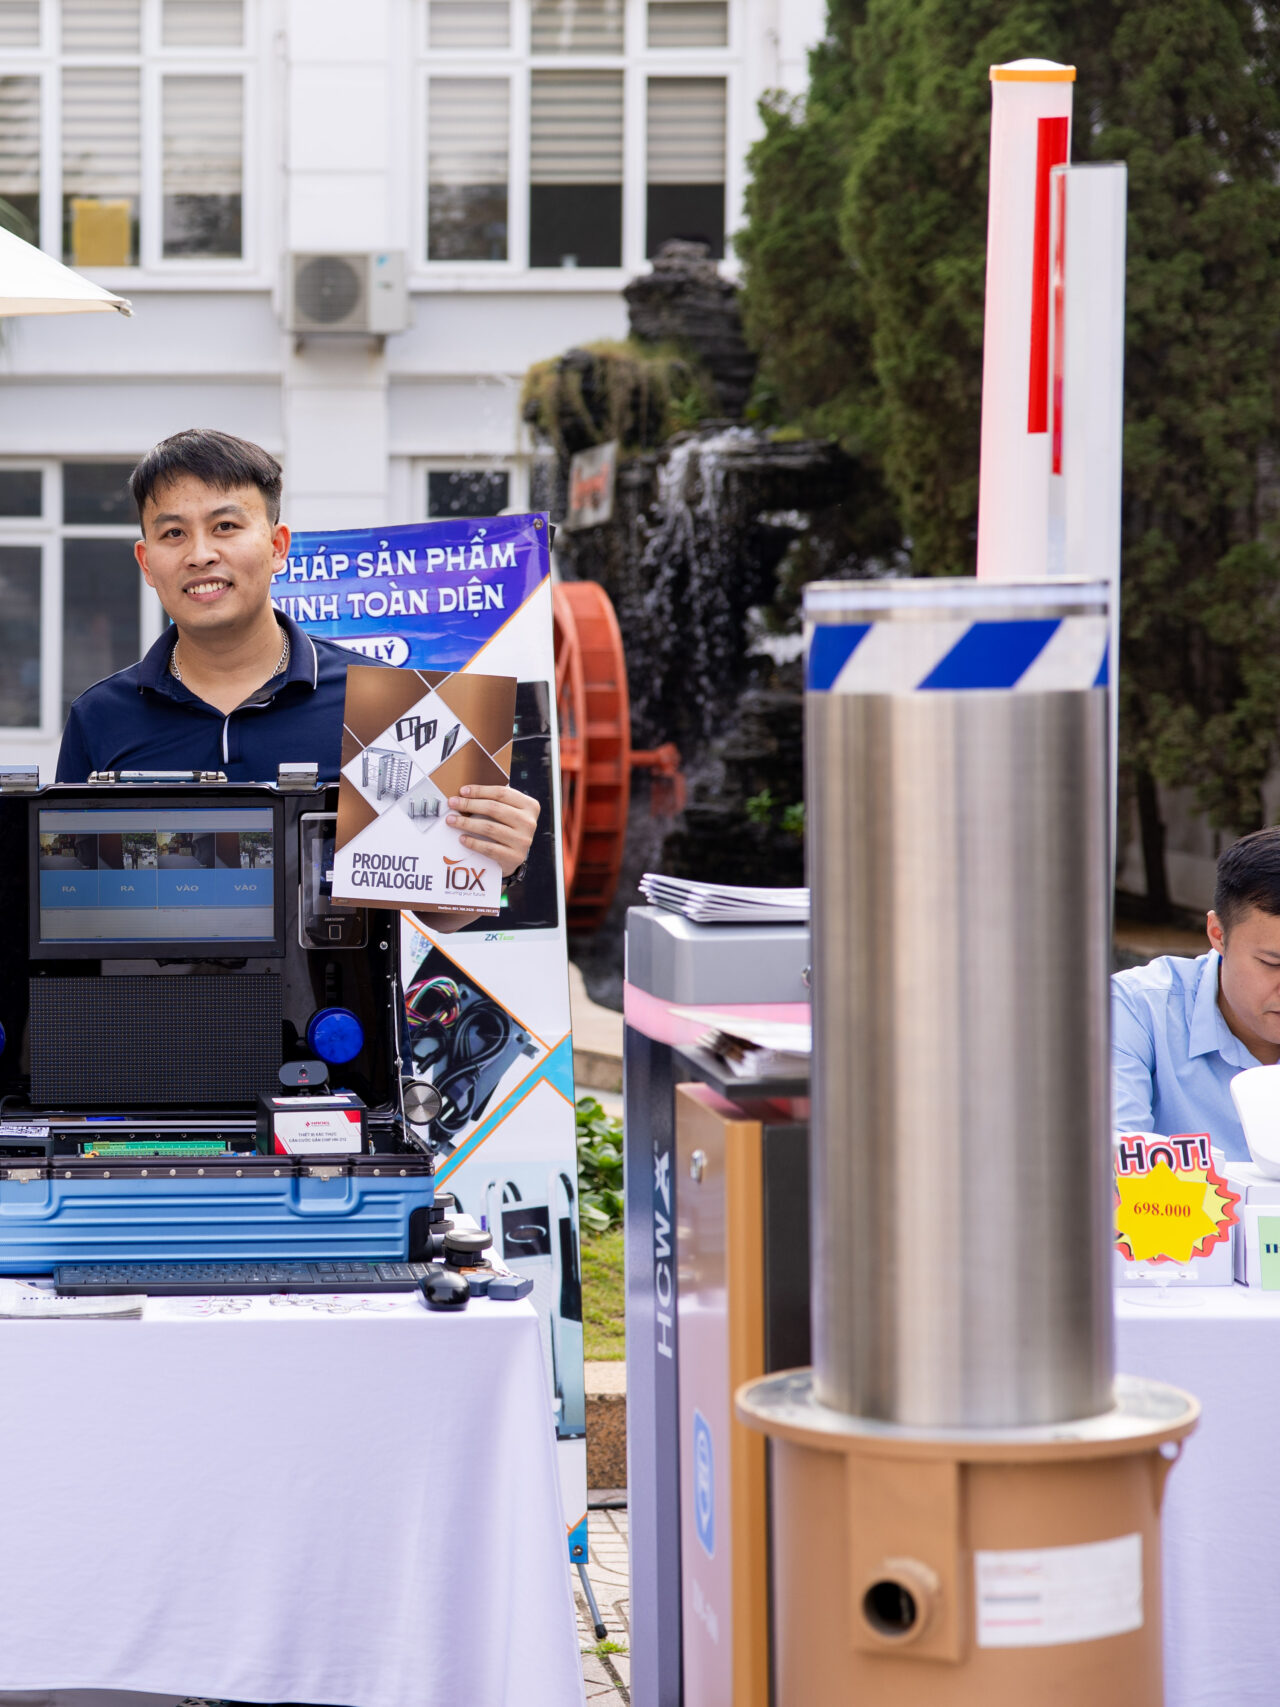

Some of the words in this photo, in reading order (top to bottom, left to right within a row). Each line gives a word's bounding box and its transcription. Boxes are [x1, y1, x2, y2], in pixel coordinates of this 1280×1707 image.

[357, 541, 416, 578] SẢN
[426, 528, 517, 573] PHẨM
[347, 582, 429, 618] TOÀN
[438, 576, 504, 618] DIỆN
[375, 640, 395, 660] LÝ
[352, 853, 419, 872] PRODUCT
[351, 870, 433, 890] CATALOGUE
[1119, 1138, 1209, 1171] HOT!
[1134, 1202, 1191, 1217] 698.000
